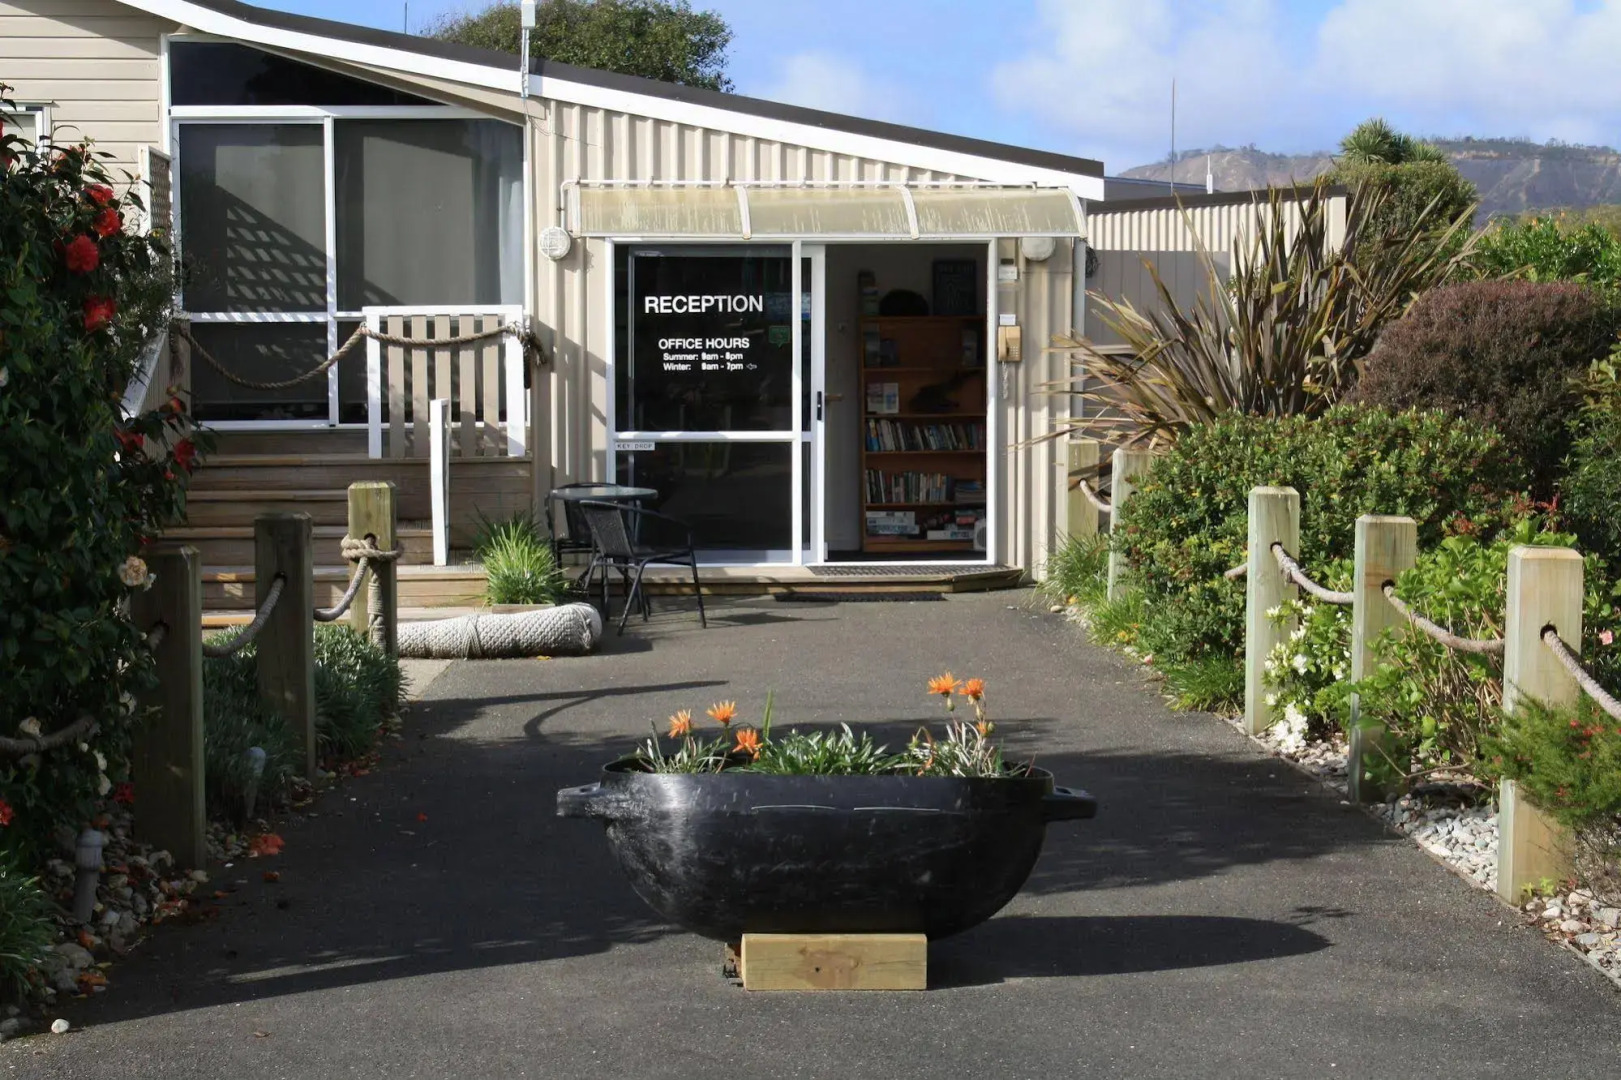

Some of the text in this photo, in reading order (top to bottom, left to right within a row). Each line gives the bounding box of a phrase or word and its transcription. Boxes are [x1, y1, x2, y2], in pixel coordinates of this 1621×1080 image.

[644, 295, 764, 314] RECEPTION
[658, 337, 750, 350] OFFICE HOURS
[663, 352, 699, 361] Summer:
[663, 362, 692, 371] Winter:
